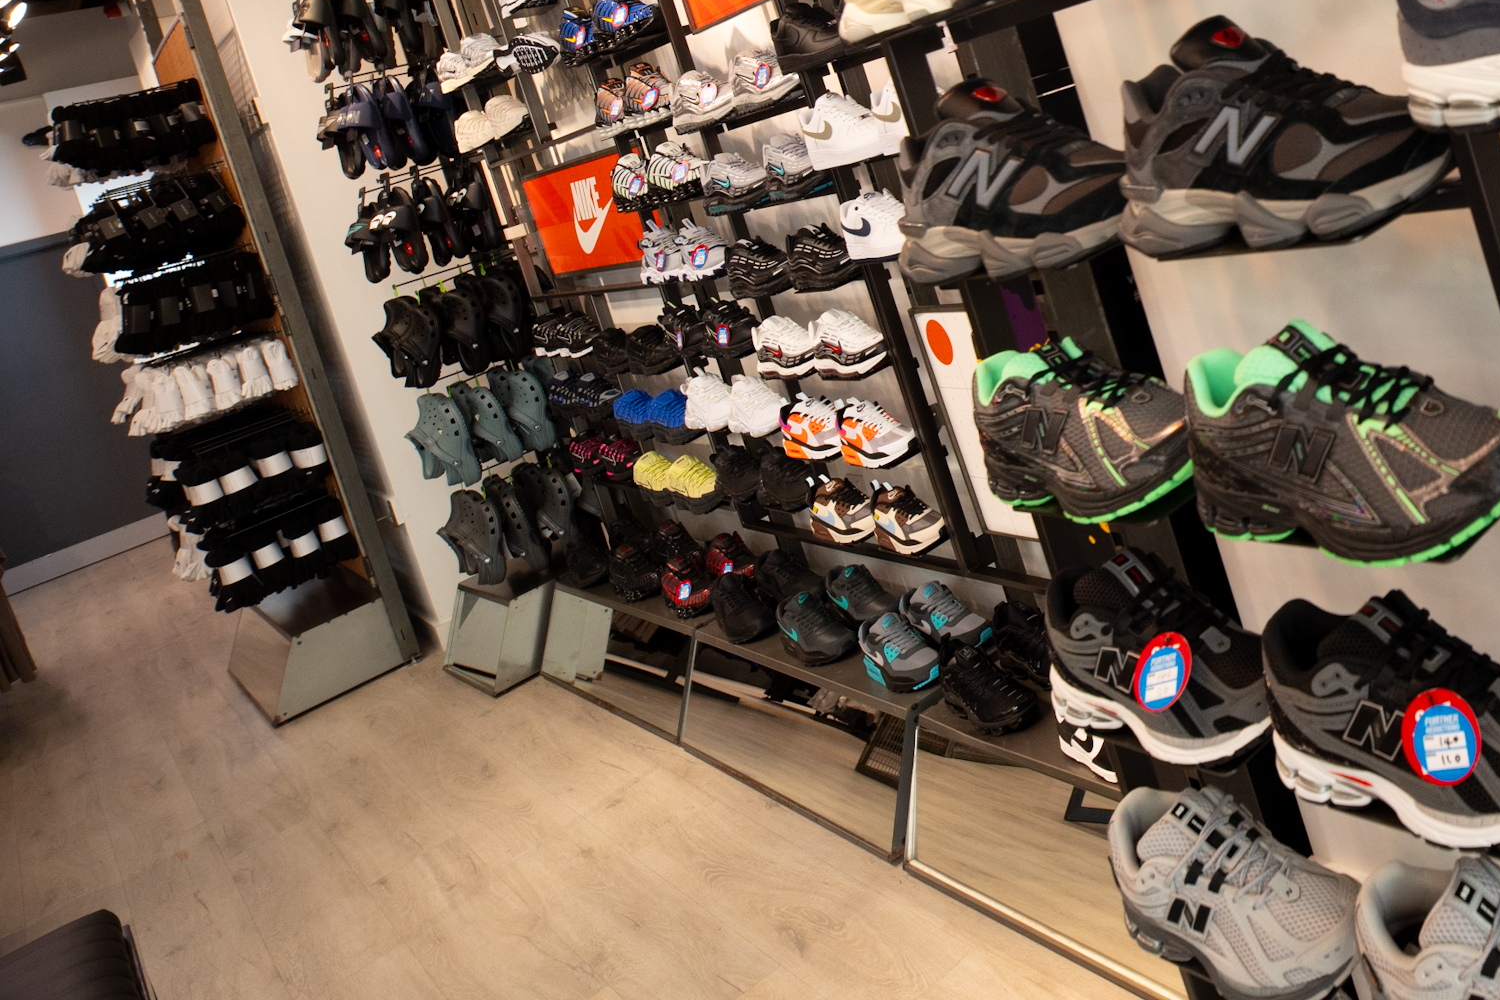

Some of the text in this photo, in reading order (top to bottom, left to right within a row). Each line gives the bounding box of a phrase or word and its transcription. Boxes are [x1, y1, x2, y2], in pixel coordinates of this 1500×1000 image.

[1193, 106, 1279, 169] N
[570, 176, 603, 221] NIKE
[947, 149, 1024, 208] N
[1020, 406, 1068, 455] N
[1267, 424, 1335, 483] N
[1094, 646, 1142, 693] N
[1342, 699, 1406, 761] N
[1424, 713, 1459, 727] FURTHER
[1163, 895, 1215, 941] N
